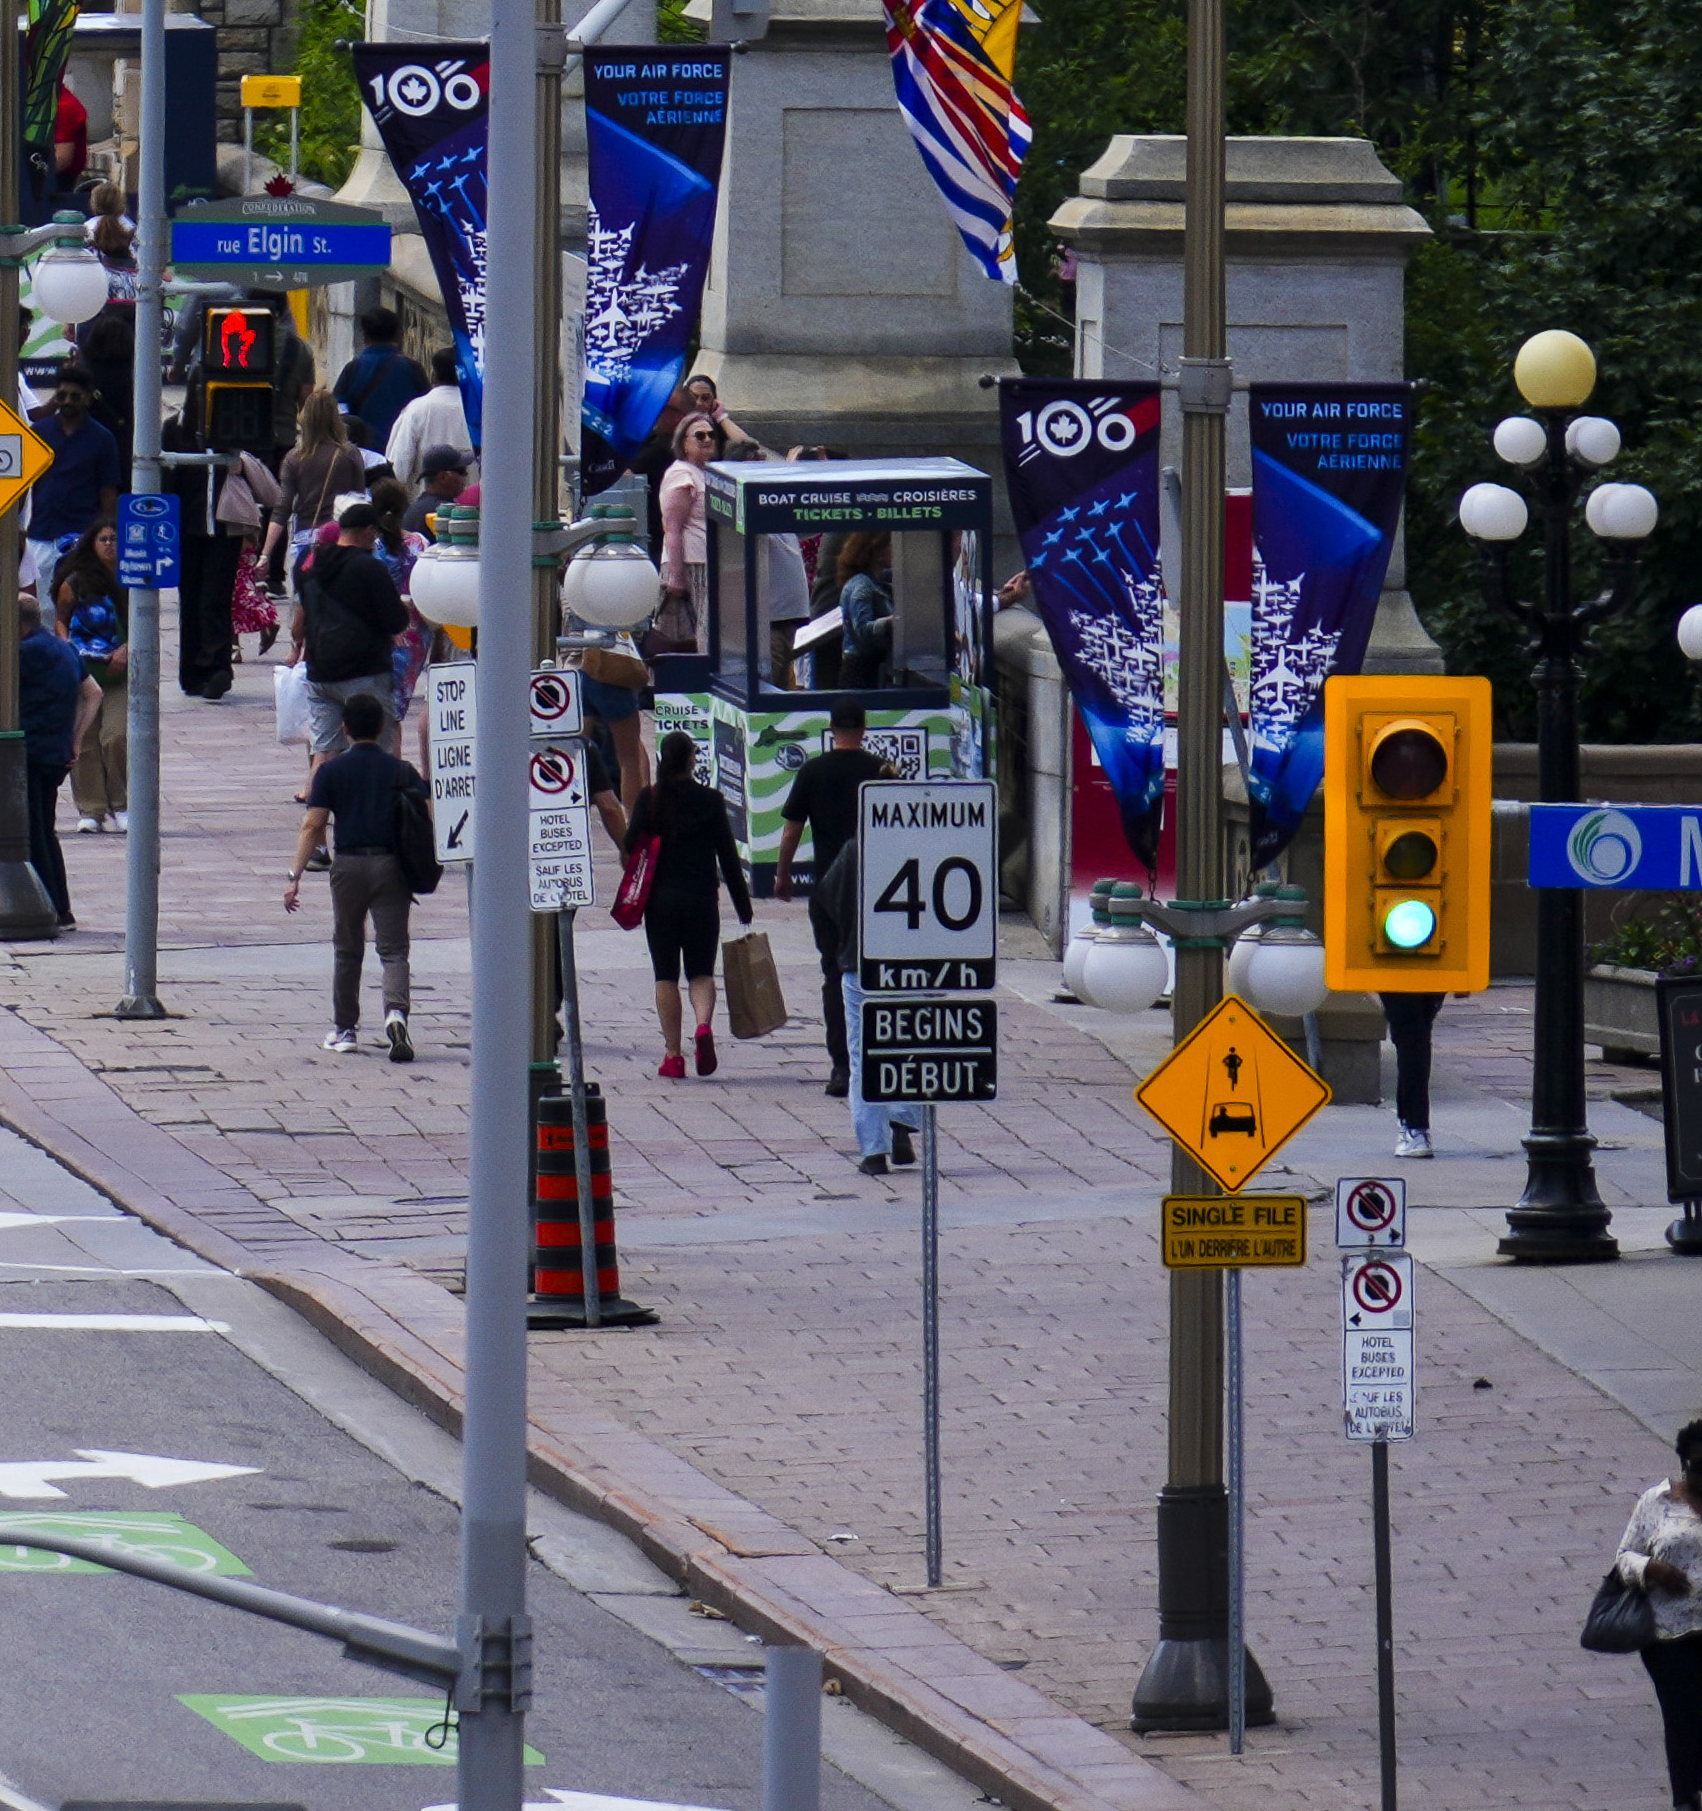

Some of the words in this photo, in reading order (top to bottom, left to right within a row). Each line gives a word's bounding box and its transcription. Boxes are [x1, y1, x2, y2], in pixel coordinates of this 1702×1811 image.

[594, 64, 637, 80] YOUR
[641, 64, 666, 79] AIR
[671, 63, 722, 78] FORCE
[617, 91, 669, 106] VOTRE
[675, 90, 723, 105] FORCE
[647, 108, 723, 124] AÉRIENNE
[217, 239, 241, 254] rue
[248, 226, 304, 261] Elgin
[313, 236, 331, 254] St.
[1261, 402, 1307, 418] YOUR
[1312, 402, 1341, 418] AIR
[1347, 403, 1403, 418] FORCE
[1287, 433, 1342, 449] VOTRE
[1348, 433, 1403, 449] FORCE
[1317, 450, 1402, 469] AÉRIENNE
[758, 493, 797, 506] BOAT
[801, 492, 851, 505] CRUISE
[893, 489, 978, 503] CROISIÈRES
[793, 507, 863, 521] TICKETS
[877, 505, 942, 519] BILLETS
[436, 680, 466, 703] STOP
[655, 705, 699, 716] CRUISE
[440, 710, 465, 732] LINE
[437, 745, 472, 769] LIGNE
[540, 814, 571, 825] HOTEL
[871, 802, 986, 829] MAXIMUM
[540, 827, 573, 838] BUSES
[533, 840, 583, 853] EXCEPTED
[536, 864, 560, 877] SAUF
[563, 863, 583, 874] LES
[533, 891, 547, 903] DE
[873, 856, 983, 932] 40
[879, 962, 978, 988] km/h
[876, 1008, 984, 1041] BEGINS
[880, 1055, 979, 1094] DÉBUT
[1172, 1206, 1245, 1227] SINGLE
[1254, 1206, 1296, 1226] FILE
[1172, 1240, 1195, 1258] L'UN
[1254, 1238, 1296, 1257] L'AUTRE
[1362, 1337, 1394, 1348] HOTEL
[1361, 1352, 1396, 1363] BUSES
[1352, 1366, 1405, 1378] EXCEPTED
[1384, 1391, 1403, 1403] LES
[1355, 1406, 1403, 1418] AUTOBUS
